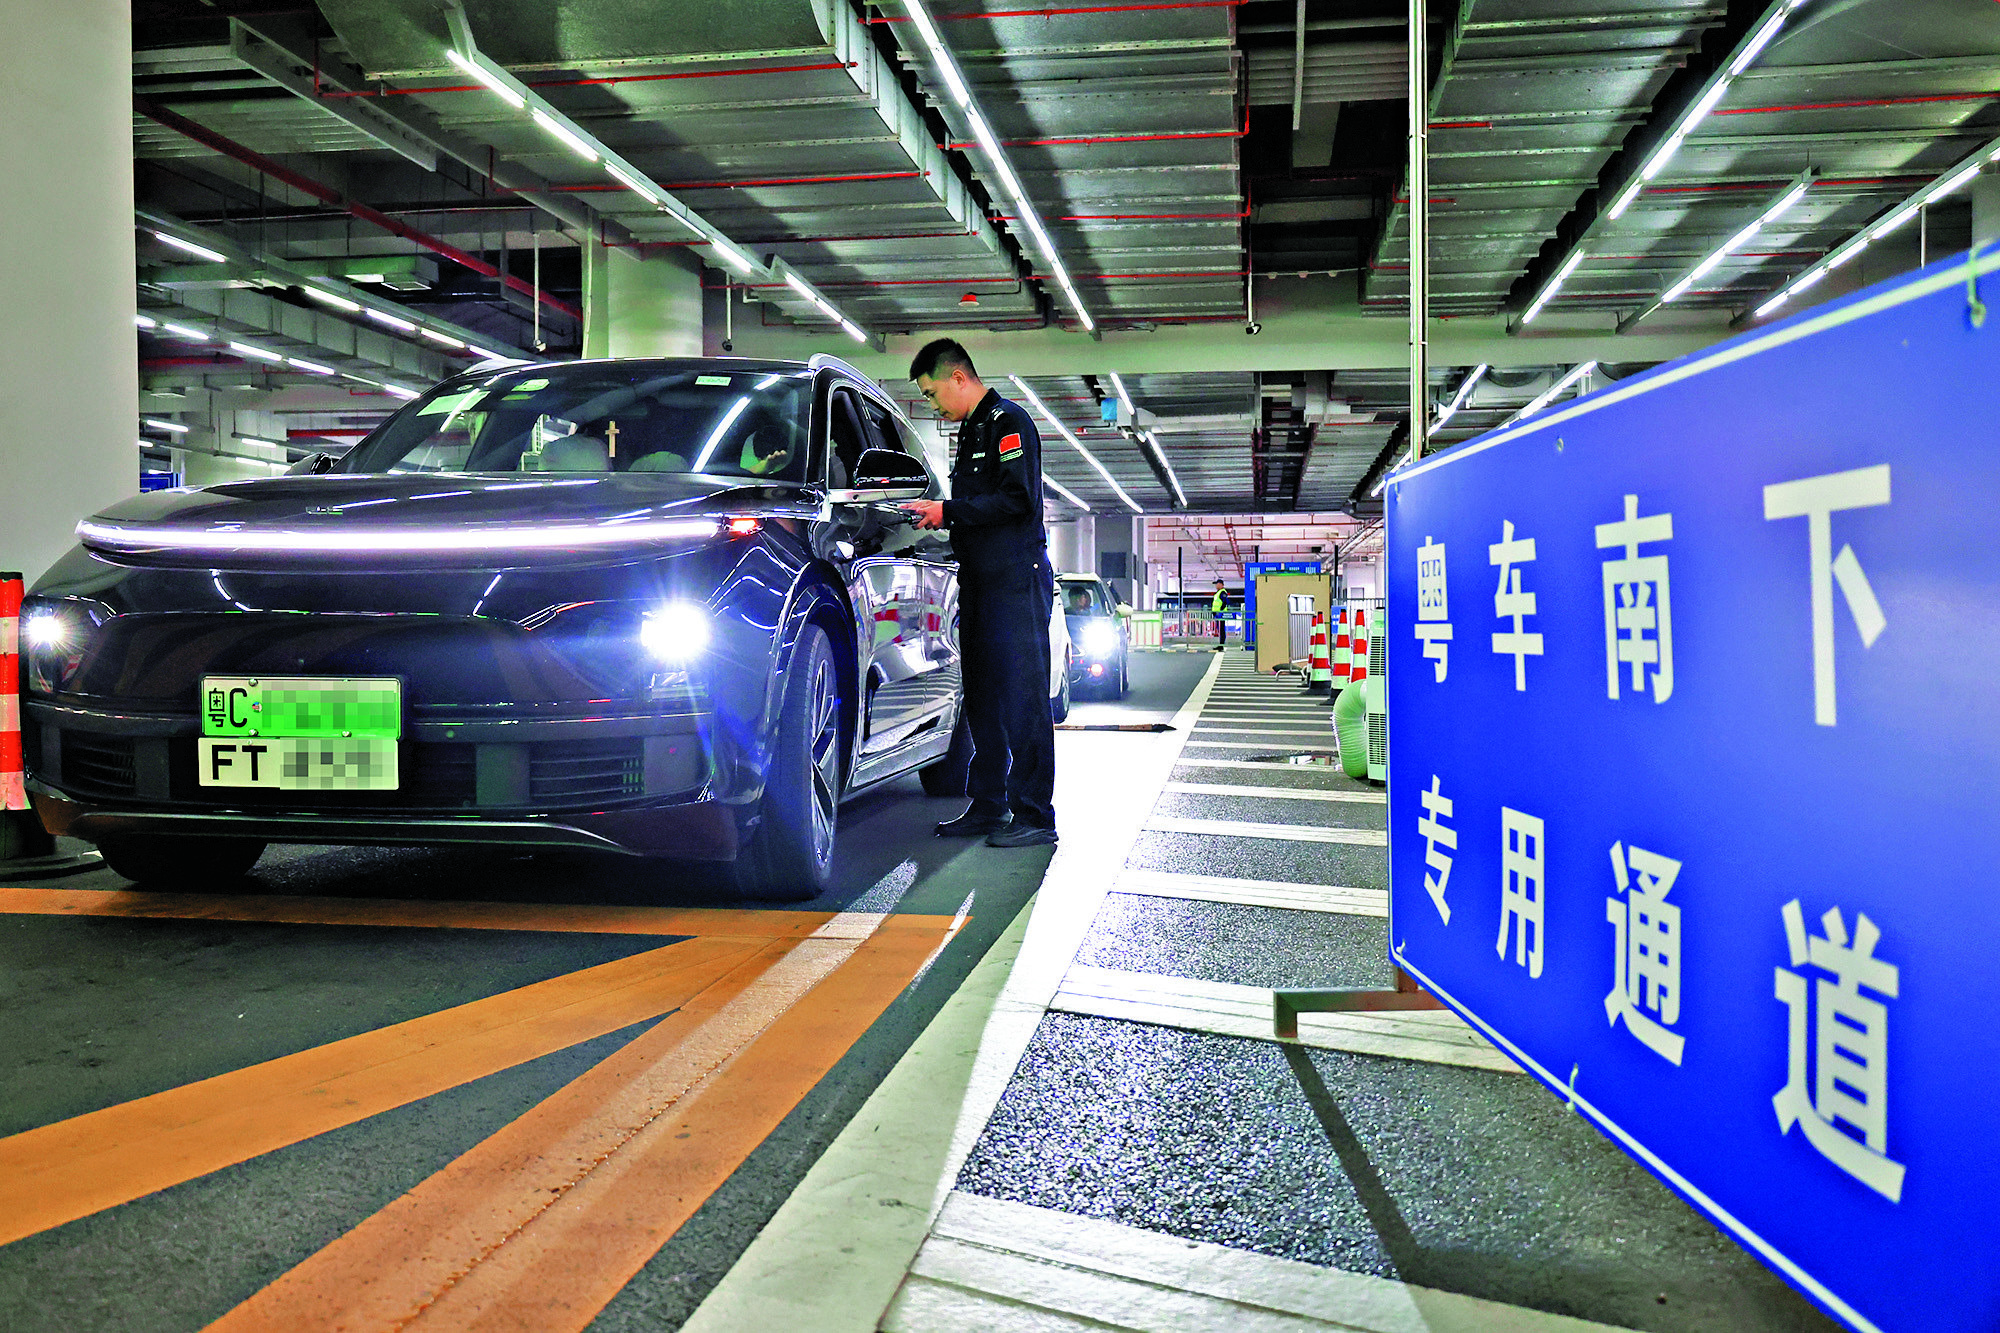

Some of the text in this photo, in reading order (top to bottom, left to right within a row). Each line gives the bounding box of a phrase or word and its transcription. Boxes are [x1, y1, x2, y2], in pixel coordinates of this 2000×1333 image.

[1413, 464, 1892, 727] 粤车南下
[211, 744, 268, 782] FT
[1416, 774, 1906, 1203] 专用通道
